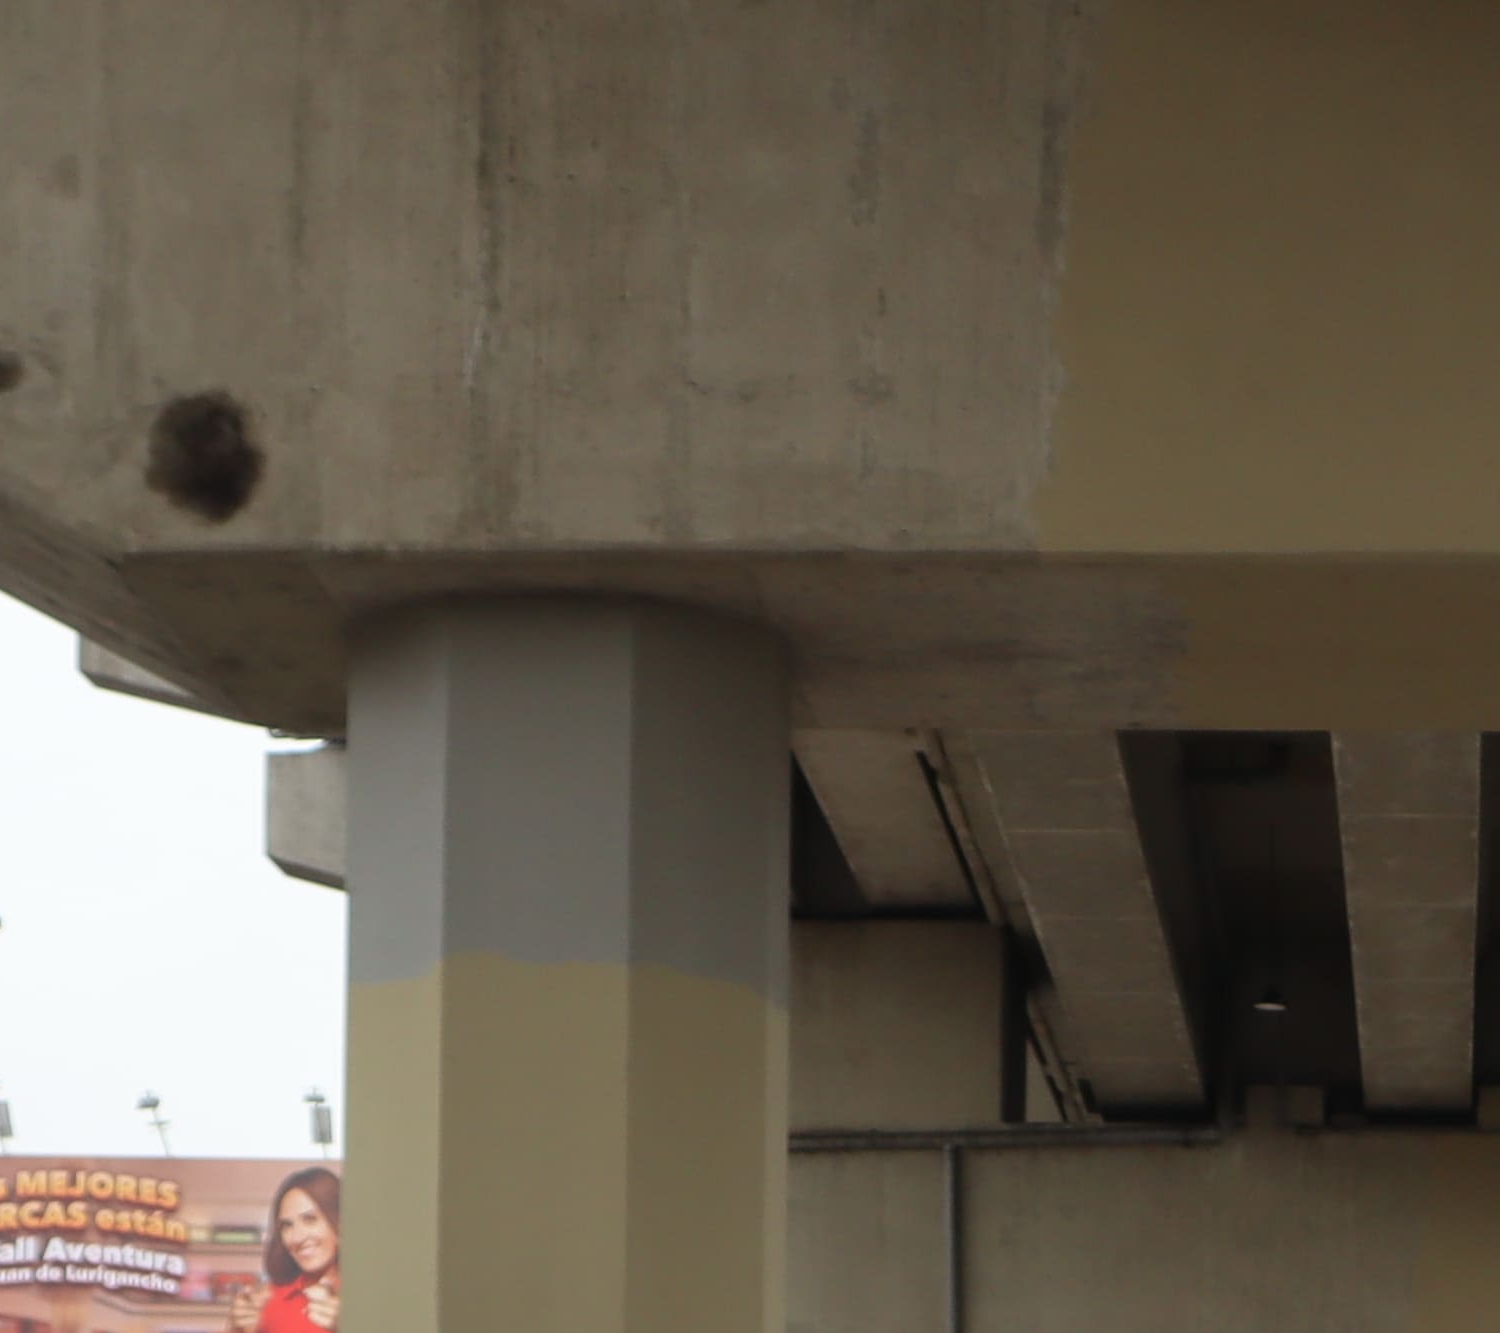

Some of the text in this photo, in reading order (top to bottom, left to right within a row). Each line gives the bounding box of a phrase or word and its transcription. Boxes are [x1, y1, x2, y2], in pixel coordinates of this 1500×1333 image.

[16, 1169, 180, 1209] MEJORES
[95, 1208, 188, 1242] están
[43, 1237, 186, 1276] Aventura
[36, 1265, 62, 1281] de
[66, 1265, 180, 1295] Lurigancho
